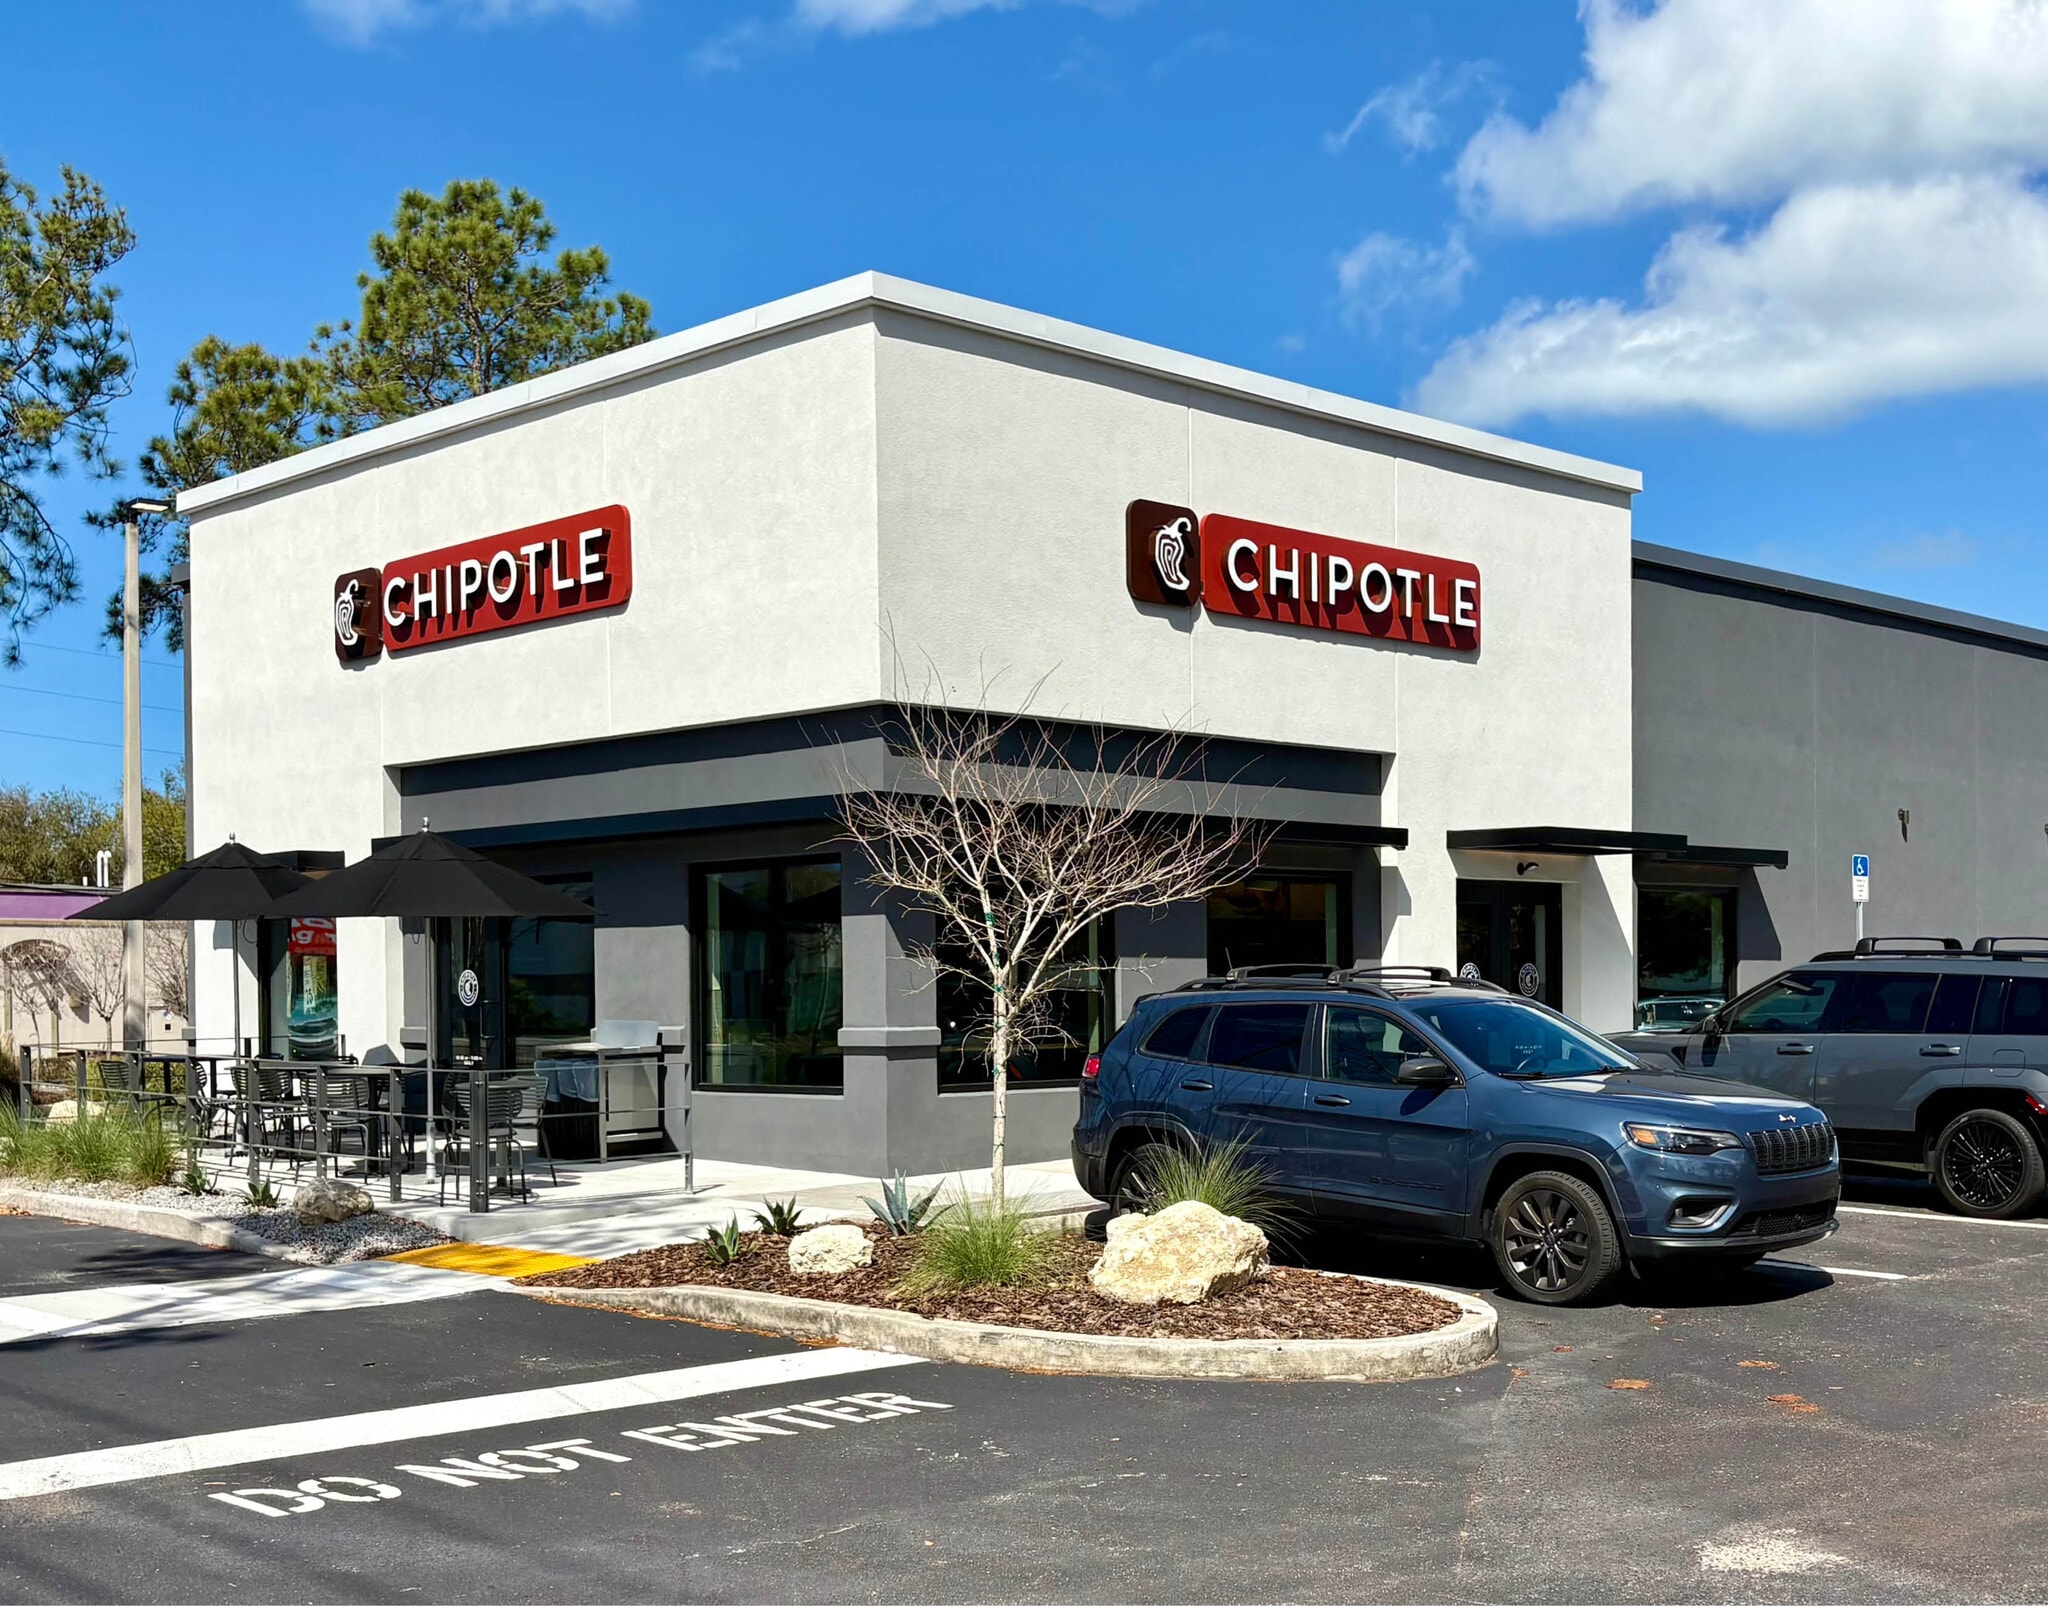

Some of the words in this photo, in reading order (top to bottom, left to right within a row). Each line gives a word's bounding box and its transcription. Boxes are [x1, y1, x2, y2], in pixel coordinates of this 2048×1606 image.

[384, 528, 604, 627] CHIPOTLE
[1227, 538, 1477, 628] CHIPOTLE
[208, 1476, 402, 1518] DO
[394, 1438, 633, 1488] NOT
[621, 1392, 954, 1452] ENTER
